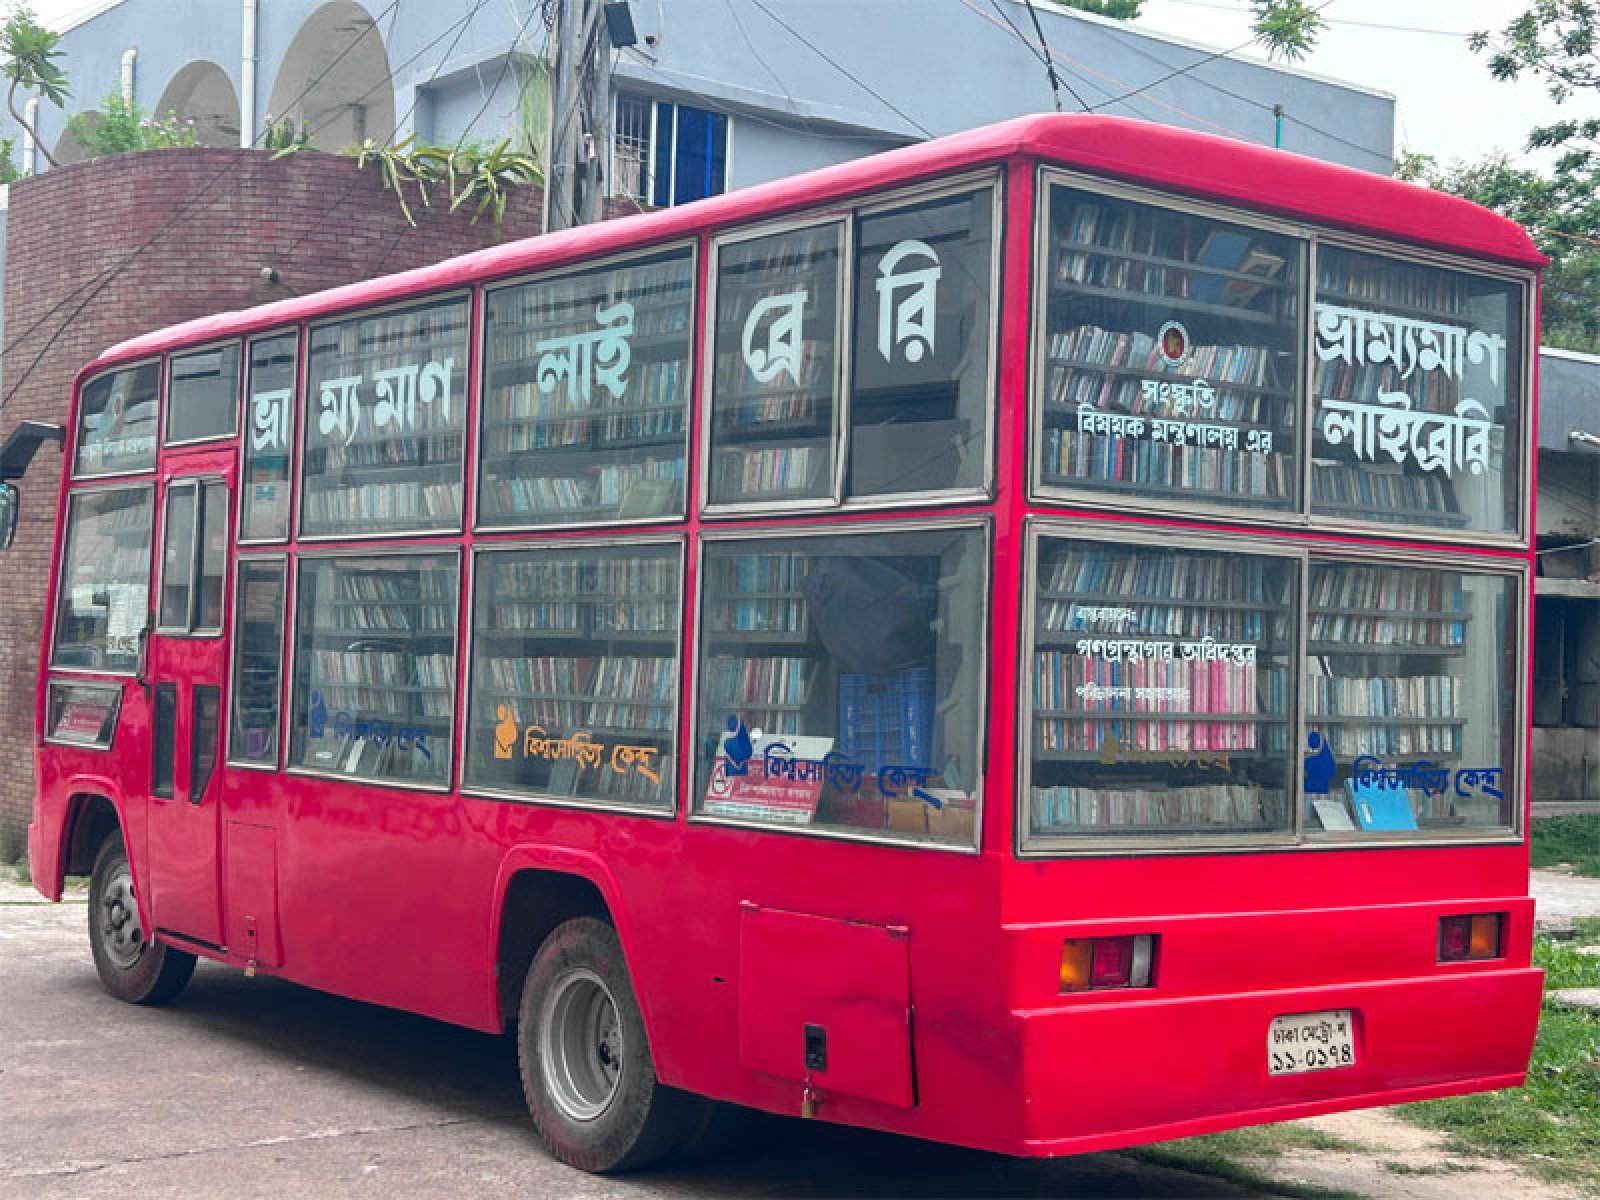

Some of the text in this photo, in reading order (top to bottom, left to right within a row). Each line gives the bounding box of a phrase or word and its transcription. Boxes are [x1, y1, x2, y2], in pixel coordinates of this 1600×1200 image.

[1314, 302, 1506, 386] ভ্রাম্যমাণ
[1141, 377, 1215, 416] সংস্কৃতি
[1076, 402, 1145, 438] বিষয়ক
[1246, 429, 1273, 455] এর
[1320, 388, 1492, 478] লাইব্রেরি
[1075, 635, 1257, 667] গণগ্রন্থাগার অধিদপ্তর
[1273, 1027, 1299, 1045] ঢাকা
[1272, 1044, 1351, 1071] ১১-০১৭৪
